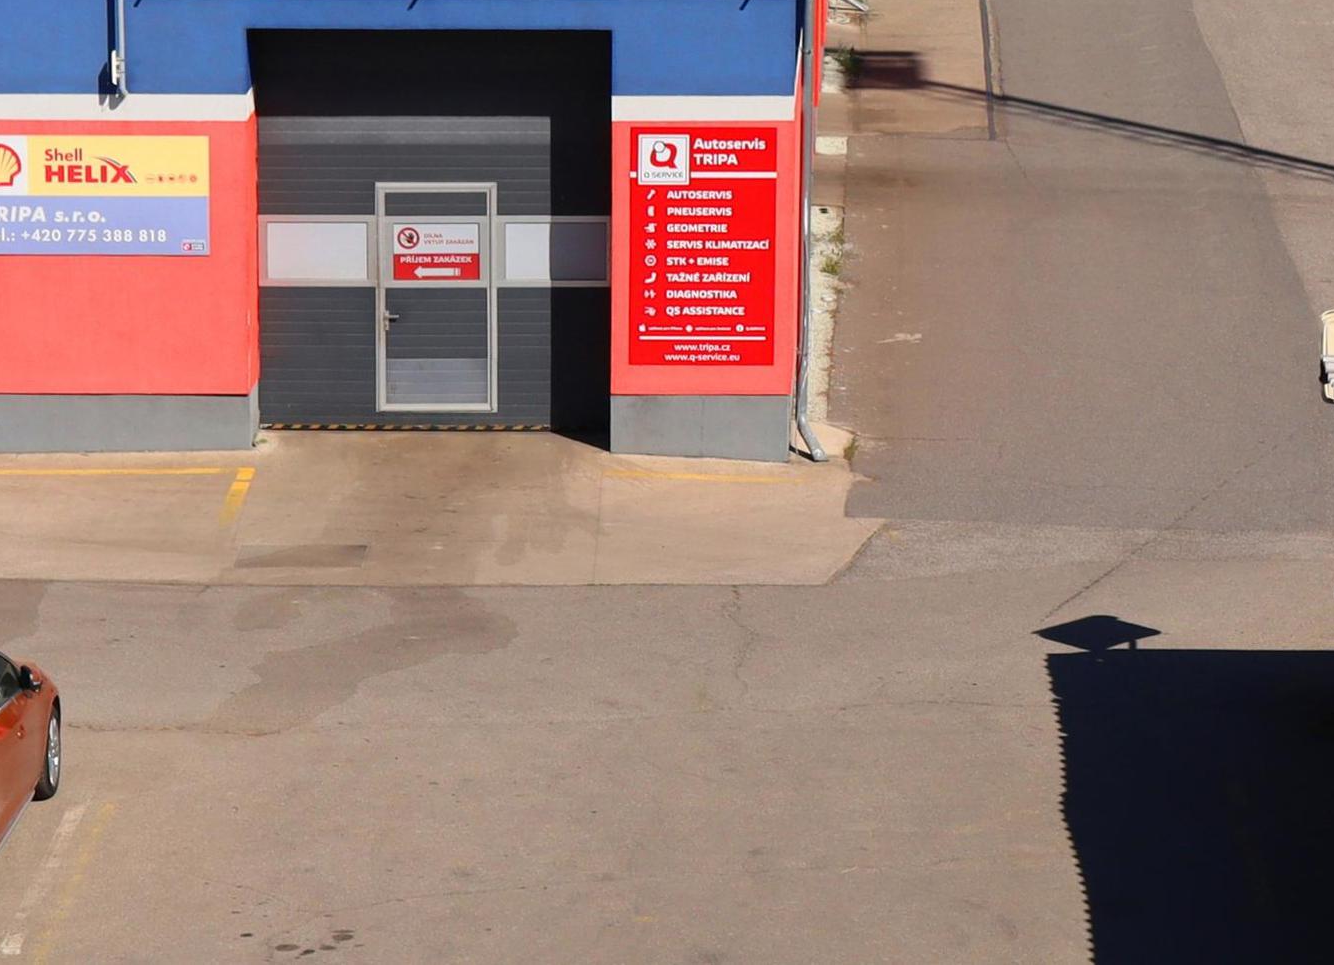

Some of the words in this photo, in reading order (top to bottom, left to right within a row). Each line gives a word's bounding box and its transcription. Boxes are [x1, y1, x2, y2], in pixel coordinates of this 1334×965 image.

[693, 137, 766, 150] Autoservis
[44, 148, 83, 162] Shell
[693, 153, 738, 165] TRIPA
[44, 165, 134, 183] HELIX
[667, 190, 732, 199] AUTOSERVIS
[54, 210, 106, 223] s.r.o.
[667, 207, 732, 216] PNEUSERVIS
[667, 224, 727, 233] GEOMETRIE
[21, 228, 62, 242] +420
[67, 229, 97, 242] 775
[103, 229, 133, 242] 388
[138, 229, 167, 242] 818
[667, 240, 703, 249] SERVIS
[705, 239, 769, 249] KLIMATIZACÍ
[433, 254, 472, 263] ZAKÁZEK
[666, 257, 686, 266] STK
[697, 257, 729, 266] EMISE
[666, 272, 700, 282] TAŽNÉ
[666, 290, 737, 299] DIAGNOSTIKA
[666, 306, 680, 316] QS
[682, 306, 745, 315] ASSISTANCE
[674, 343, 731, 352] www.tripa.cz
[664, 353, 740, 363] www.q-service.eu
